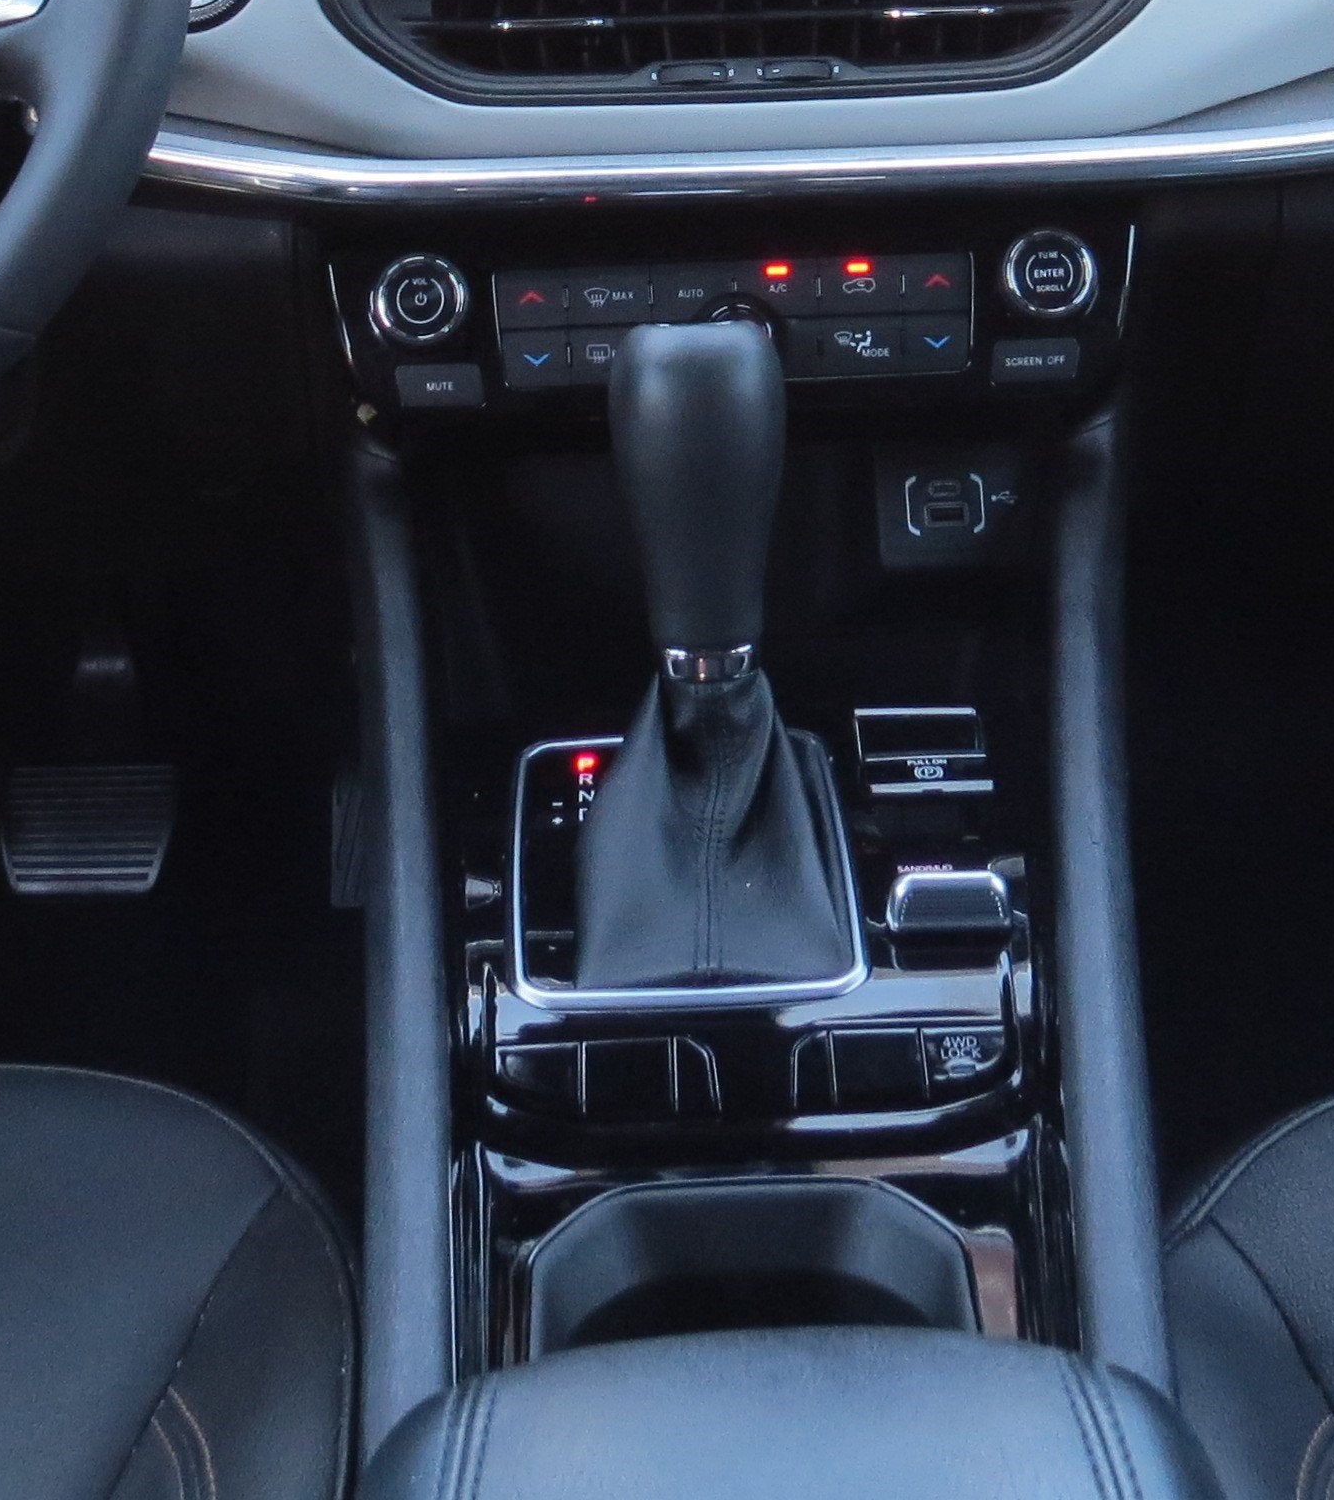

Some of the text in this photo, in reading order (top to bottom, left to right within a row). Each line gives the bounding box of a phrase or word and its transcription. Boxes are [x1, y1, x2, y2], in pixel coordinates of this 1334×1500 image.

[1033, 267, 1065, 279] ENTER
[411, 277, 428, 286] VOL
[677, 288, 704, 299] AUTO
[769, 283, 787, 294] A/C
[1035, 283, 1065, 293] SCROLL
[612, 291, 634, 301] MAX
[862, 347, 890, 358] MODE
[1005, 354, 1066, 367] SCREEN OFF
[426, 381, 454, 392] MUTE
[576, 756, 595, 772] P
[578, 773, 594, 785] R
[578, 790, 595, 802] N
[942, 1035, 978, 1048] 4WD
[940, 1047, 982, 1059] LOCK
